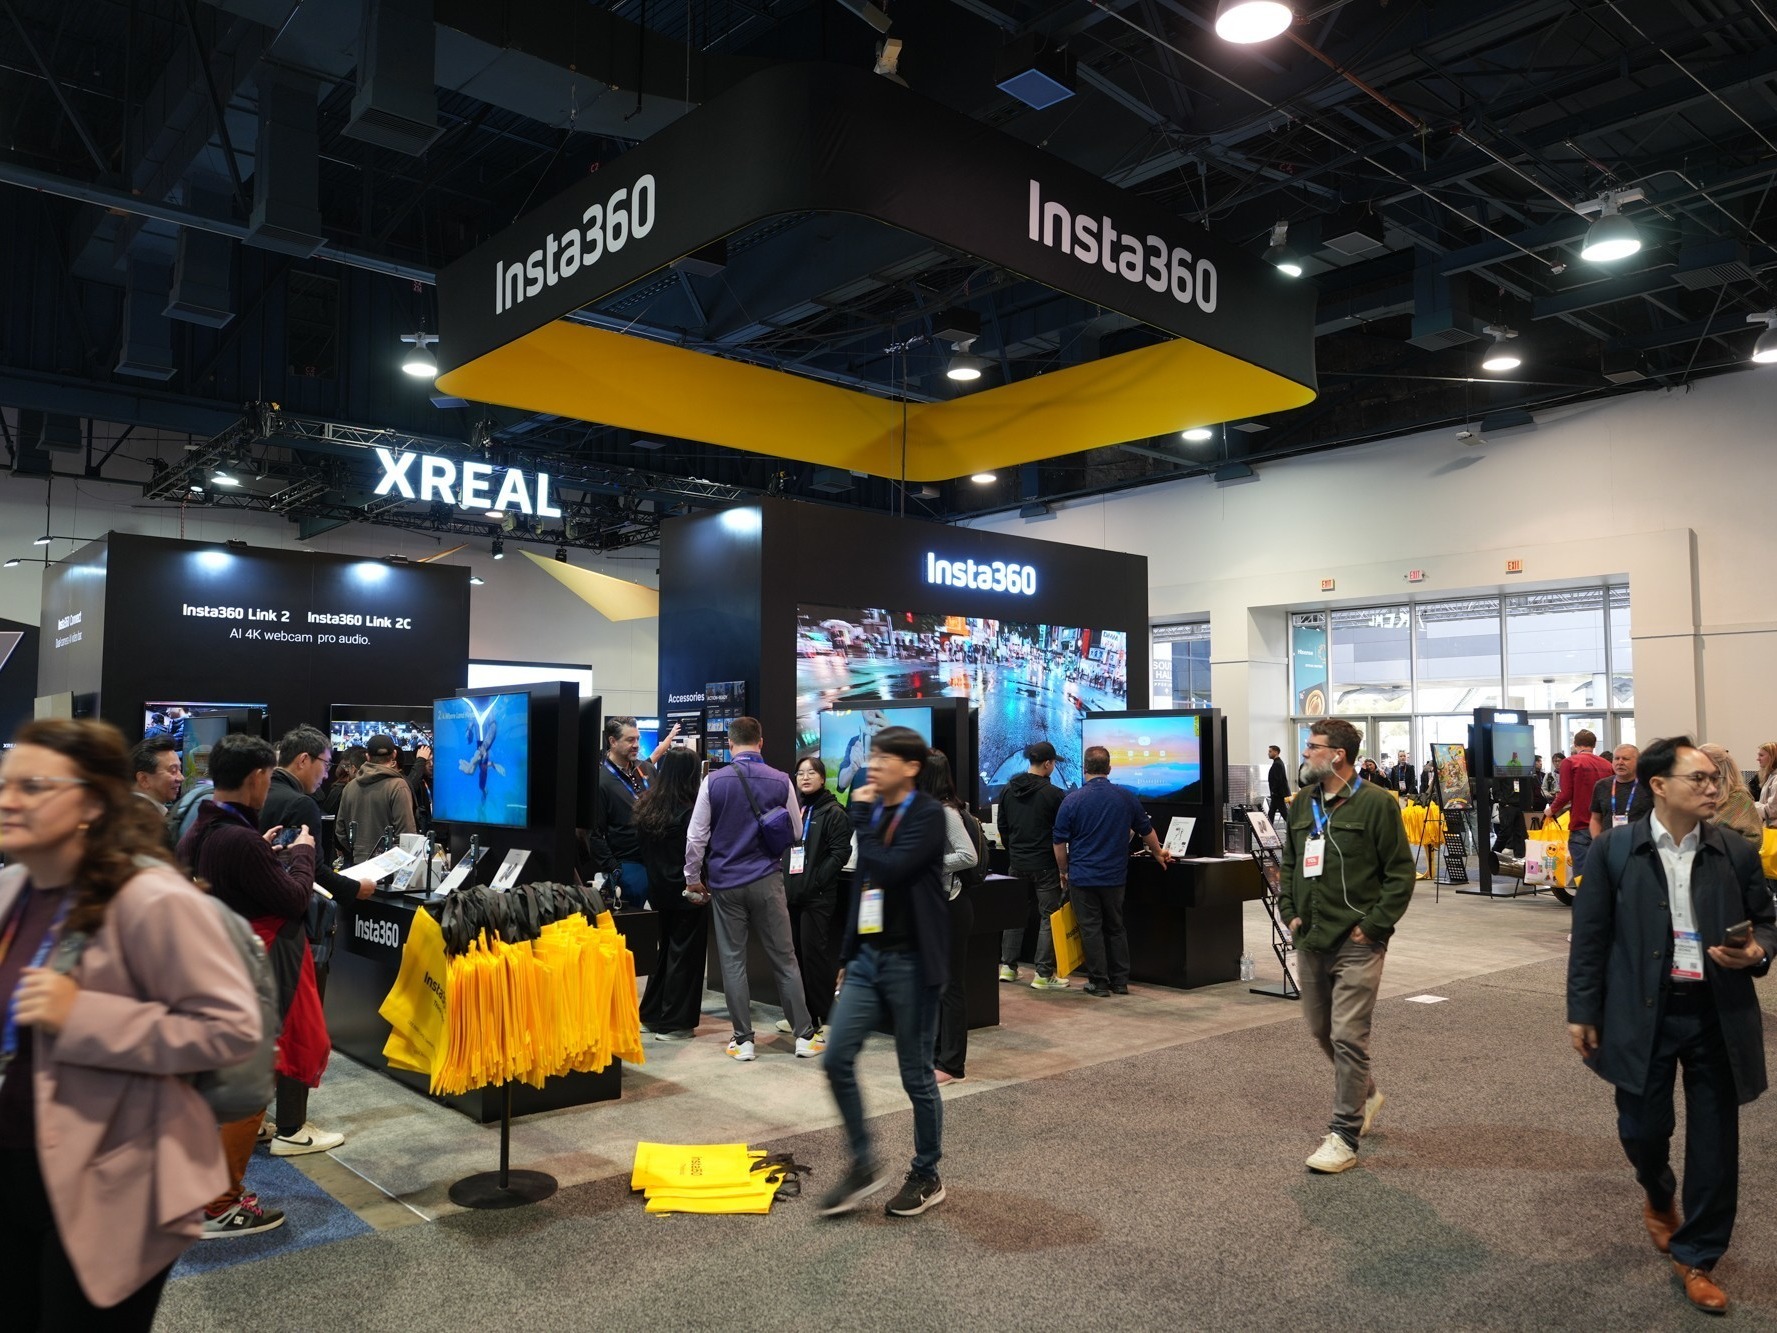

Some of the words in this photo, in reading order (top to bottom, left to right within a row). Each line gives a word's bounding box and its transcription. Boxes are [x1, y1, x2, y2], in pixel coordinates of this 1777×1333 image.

[496, 173, 656, 316] Insta360
[1029, 178, 1218, 314] Insta360
[373, 447, 562, 518] XREAL
[927, 551, 1036, 596] Insta360
[1409, 570, 1420, 580] EXIT
[1507, 560, 1520, 571] EXIT
[1321, 579, 1332, 589] EXIT
[182, 603, 244, 620] Insta360
[248, 608, 278, 622] Link
[280, 610, 290, 623] 2
[307, 611, 363, 626] Insta360
[365, 615, 392, 628] Link
[395, 617, 412, 630] 2C
[229, 627, 242, 639] AI
[244, 628, 262, 640] 4K
[264, 631, 313, 643] webcam
[317, 633, 336, 645] pro
[338, 634, 371, 645] audio.
[668, 691, 705, 704] Accessories
[355, 913, 399, 948] Insta360
